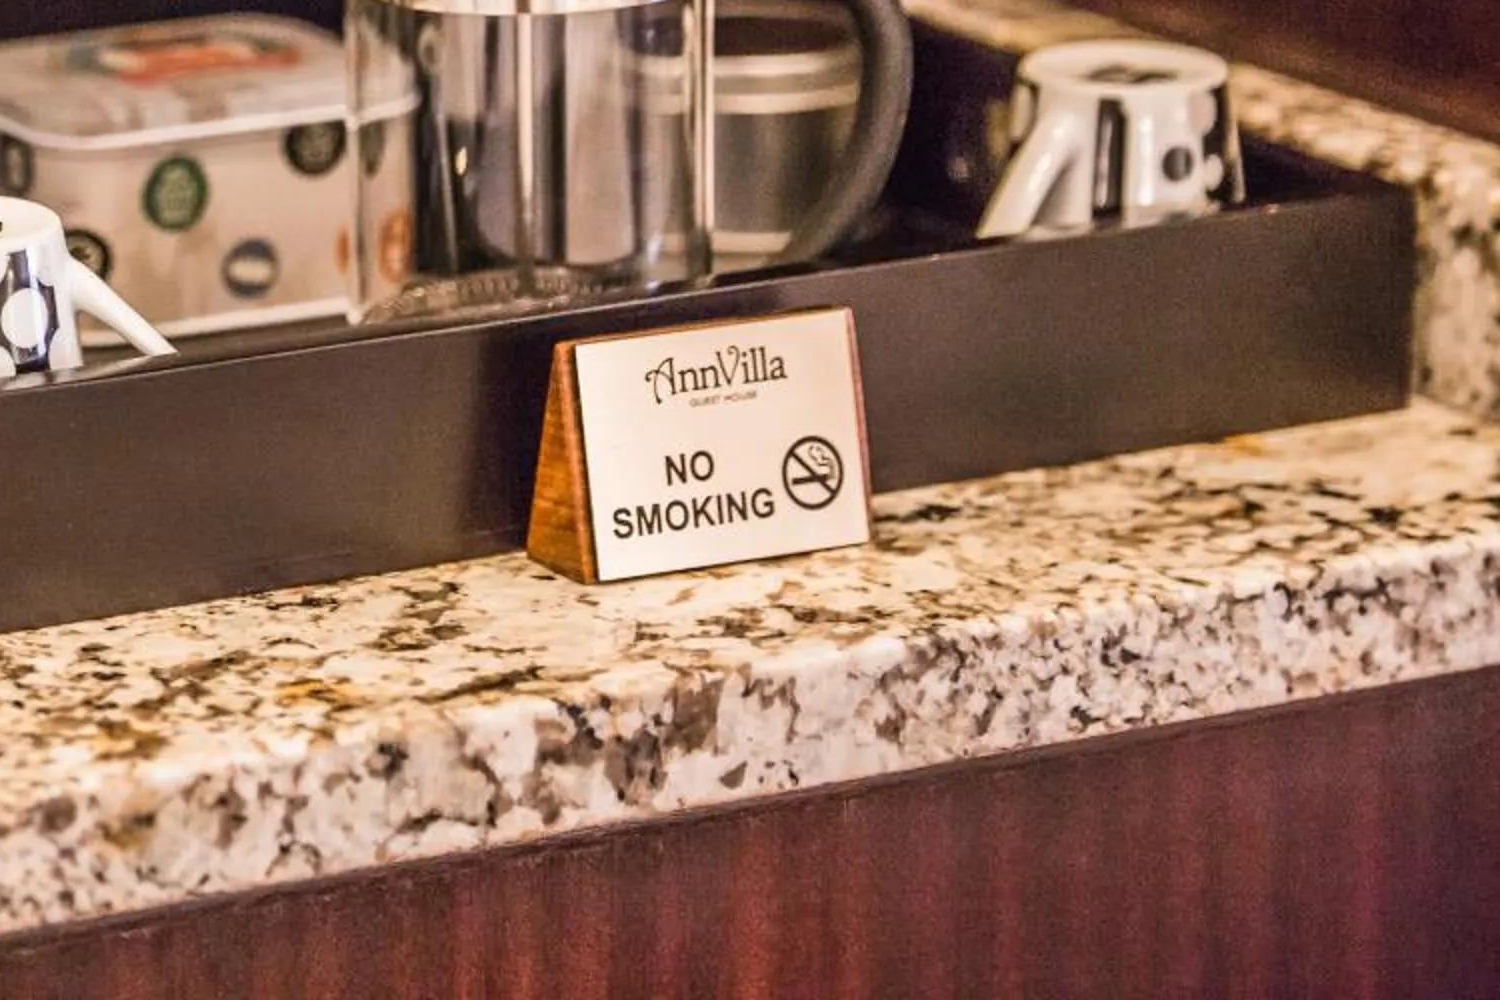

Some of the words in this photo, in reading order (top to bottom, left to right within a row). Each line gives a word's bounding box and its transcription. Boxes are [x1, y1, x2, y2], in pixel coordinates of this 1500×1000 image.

[644, 345, 788, 404] AnnVilla
[664, 450, 715, 487] NO
[612, 487, 776, 539] SMOKING
